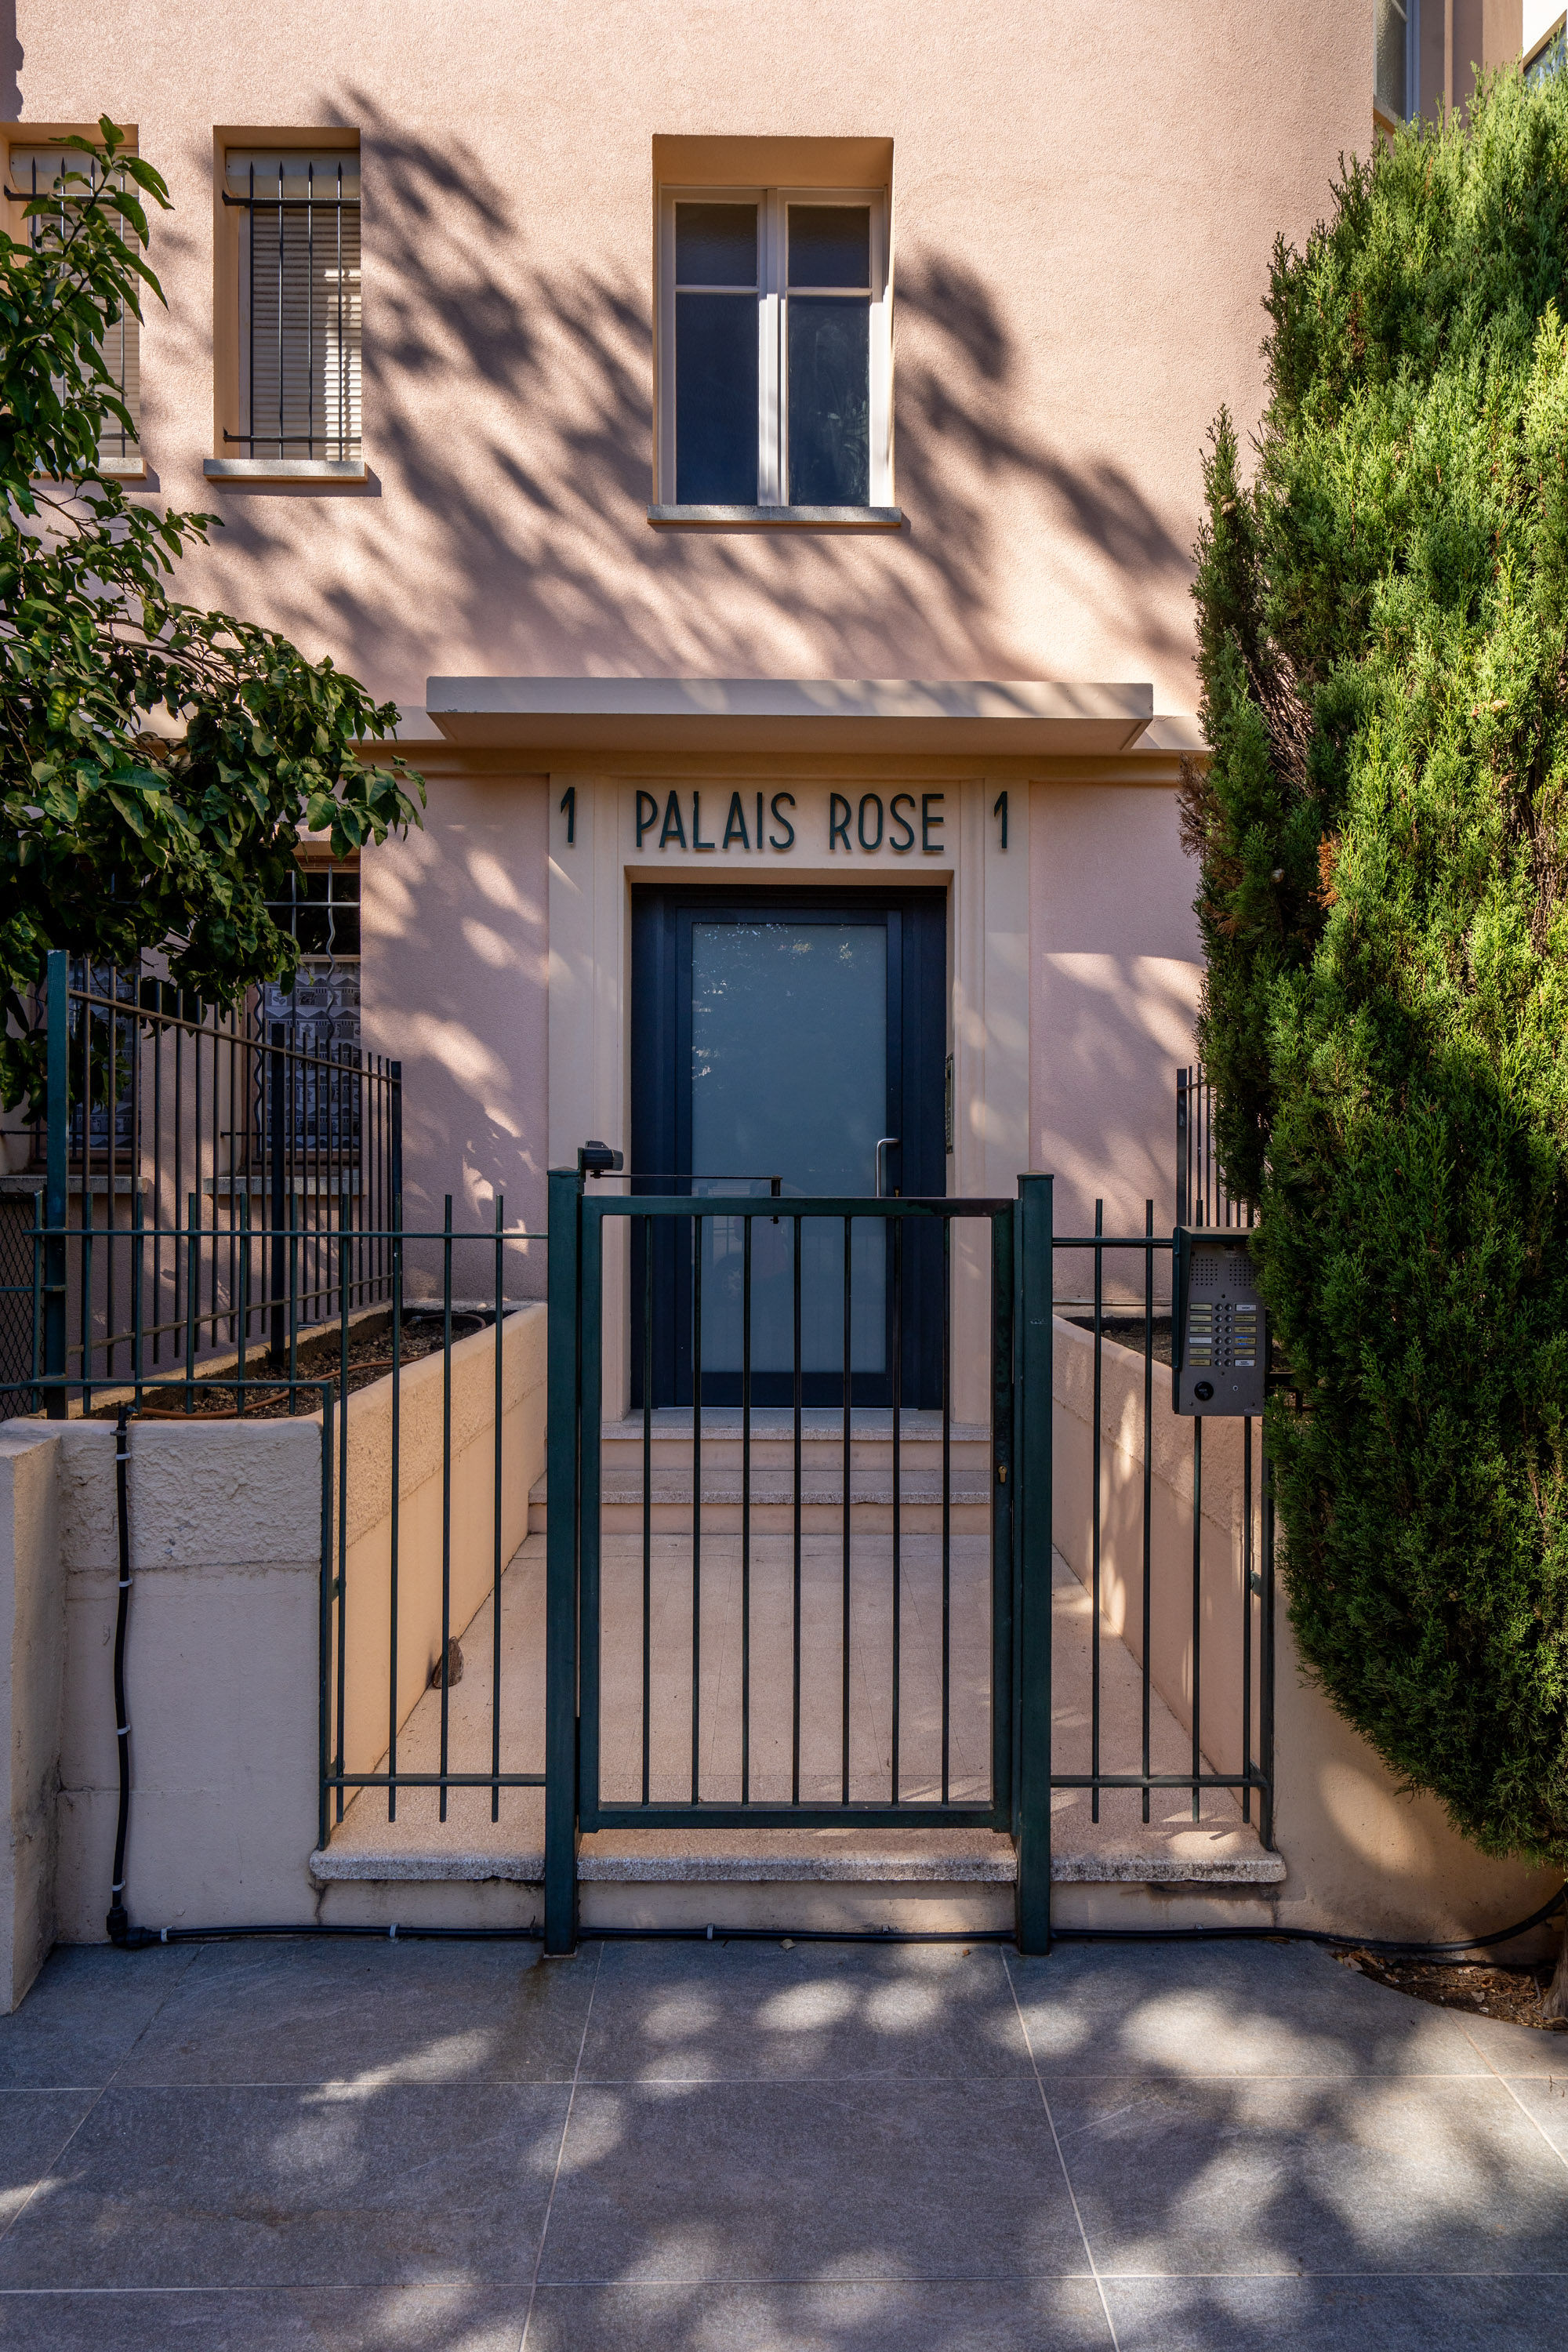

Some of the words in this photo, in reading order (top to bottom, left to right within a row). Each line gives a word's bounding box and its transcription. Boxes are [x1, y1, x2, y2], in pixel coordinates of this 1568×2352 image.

[561, 787, 575, 843] 1
[636, 790, 796, 850] PALAIS
[829, 793, 945, 851] ROSE
[993, 791, 1007, 849] 1
